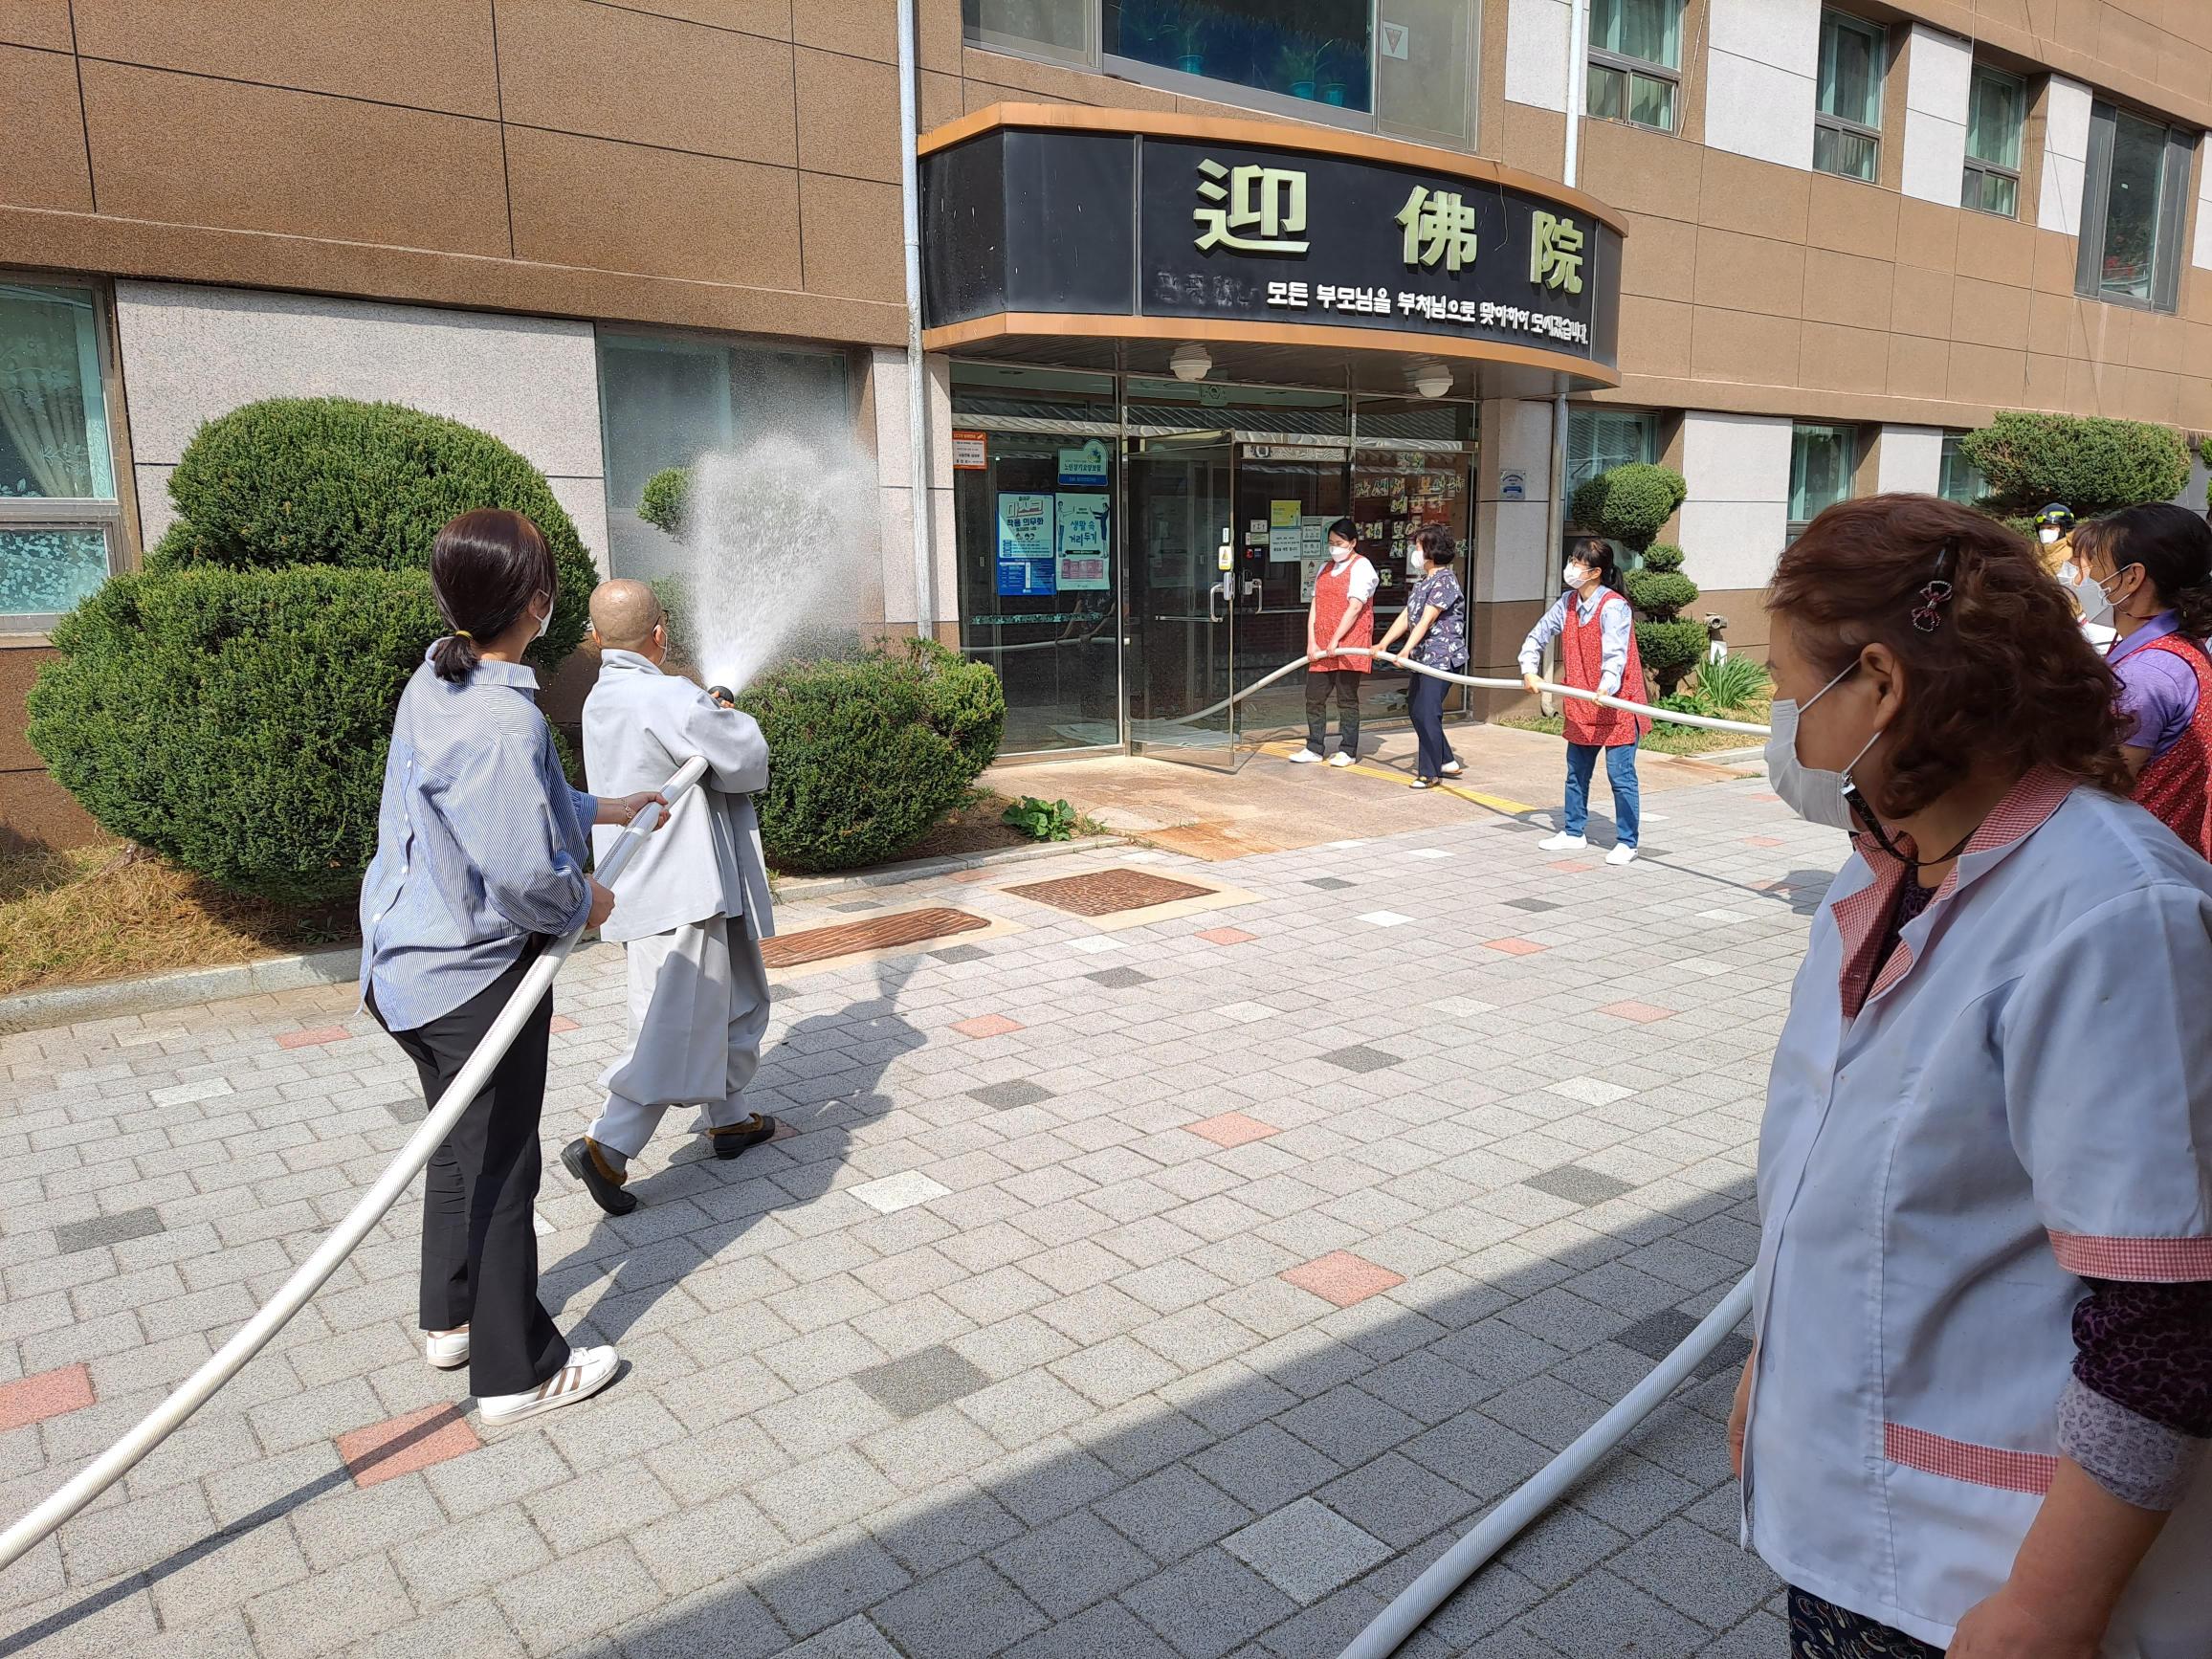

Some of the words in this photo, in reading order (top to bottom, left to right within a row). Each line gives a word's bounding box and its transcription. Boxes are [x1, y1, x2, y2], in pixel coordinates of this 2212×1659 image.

[1193, 158, 1585, 295] 迎佛院
[1266, 280, 1309, 308] 모든
[1316, 283, 1391, 315] 부모님을
[1397, 291, 1476, 323] 부처님으로
[1479, 301, 1530, 331] 맞이하여
[1069, 531, 1097, 547] 거리두기
